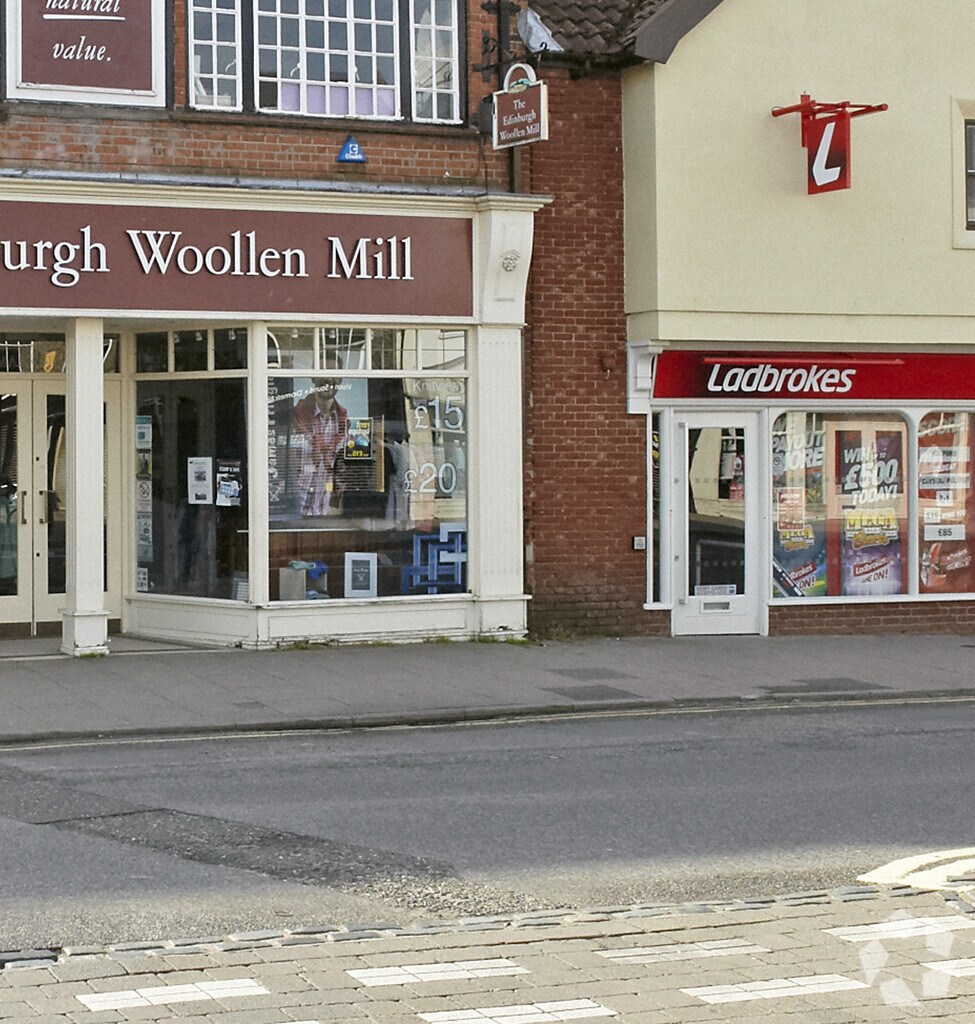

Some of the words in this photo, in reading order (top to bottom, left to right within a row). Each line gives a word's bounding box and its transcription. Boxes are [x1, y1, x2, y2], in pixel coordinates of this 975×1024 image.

[52, 36, 111, 62] value.
[503, 109, 537, 126] Edinburgh
[512, 99, 526, 110] The
[499, 128, 526, 140] Woollen
[526, 123, 540, 135] Mill
[813, 122, 841, 186] L
[127, 229, 309, 278] Woollen
[327, 236, 415, 280] Mill
[707, 363, 857, 393] Ladbrokes
[414, 395, 464, 430] £15
[404, 463, 457, 494] £20
[851, 484, 898, 506] TODAY!
[938, 528, 952, 537] £85
